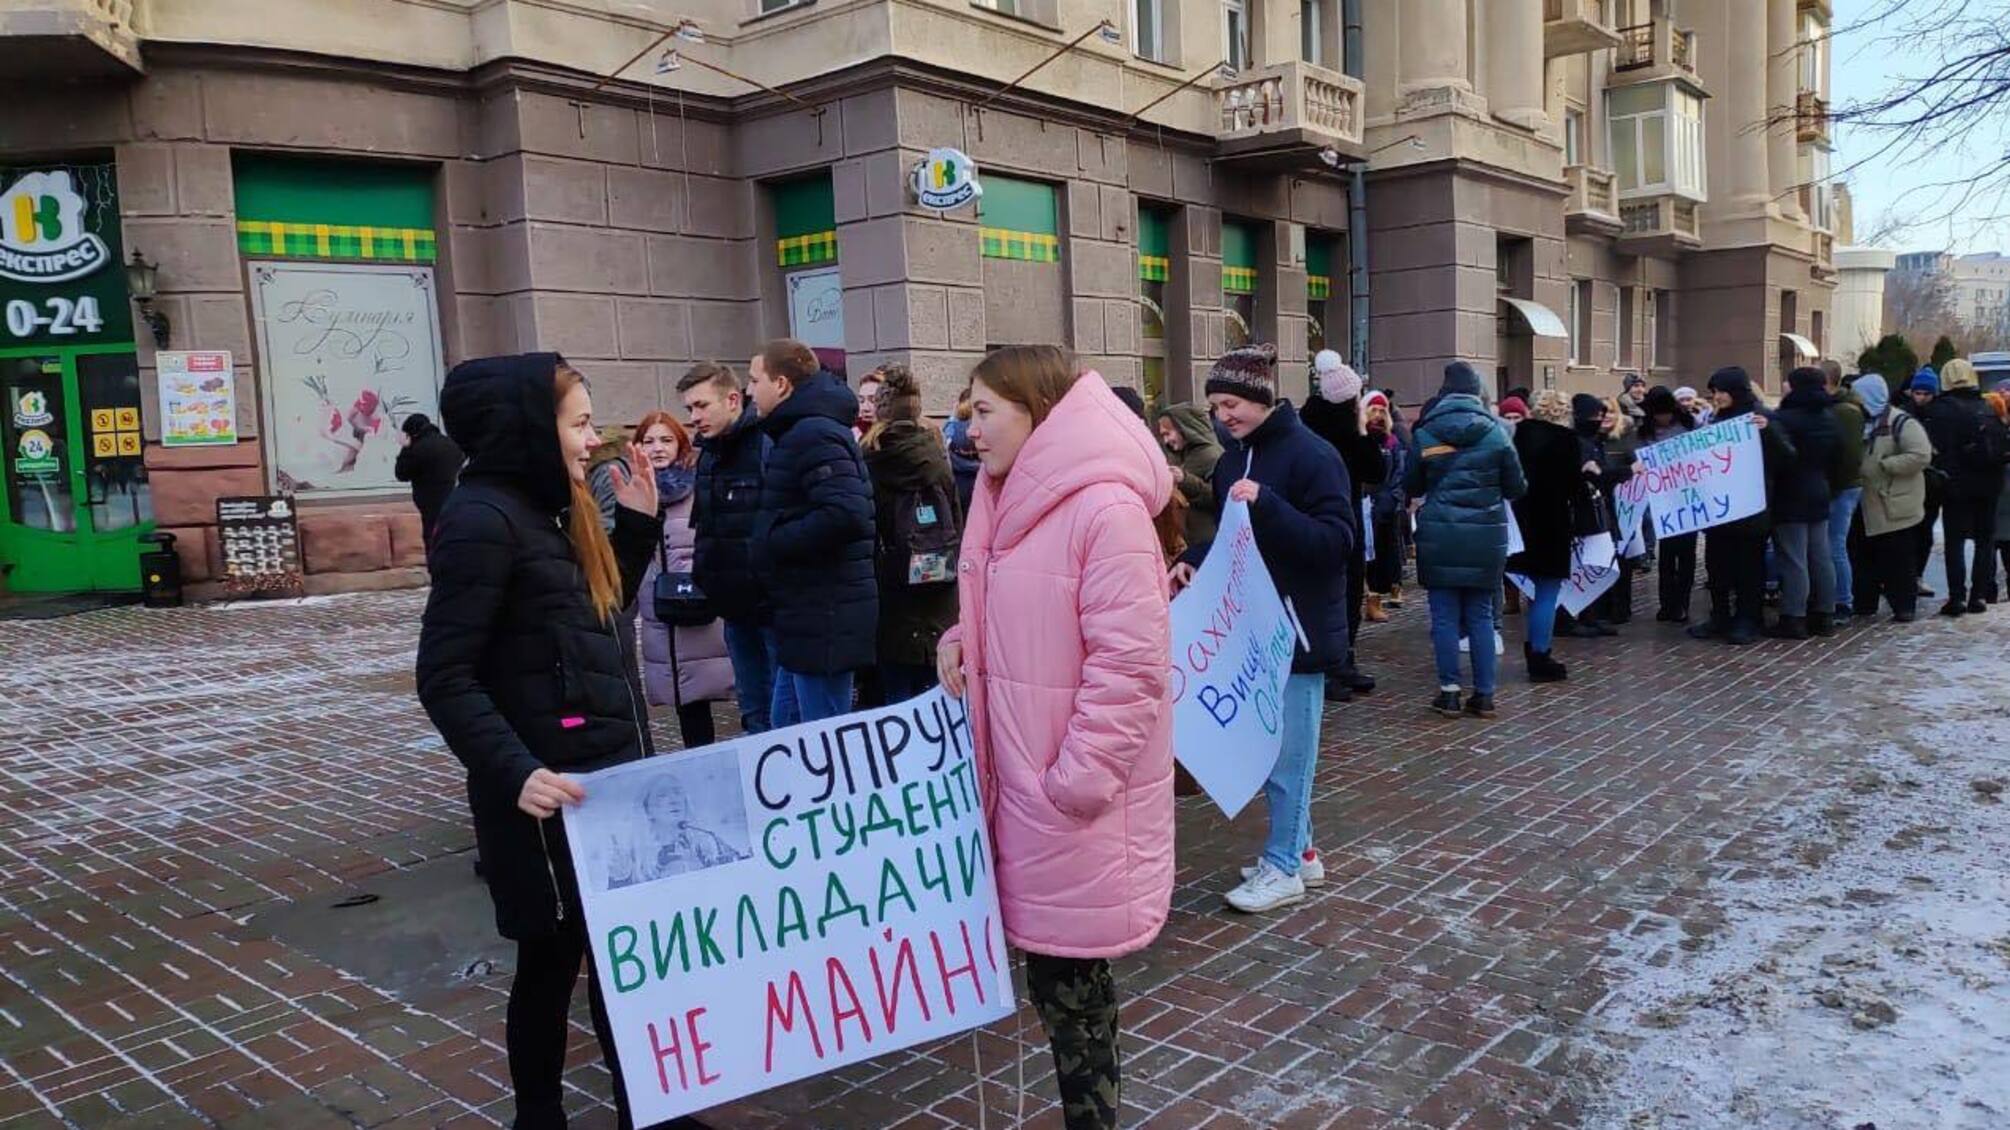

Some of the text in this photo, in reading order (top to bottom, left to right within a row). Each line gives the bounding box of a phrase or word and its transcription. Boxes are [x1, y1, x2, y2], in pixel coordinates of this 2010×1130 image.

[6, 296, 104, 338] 0-24
[1660, 494, 1730, 535] КГМУ
[647, 1007, 721, 1094] НЕ
